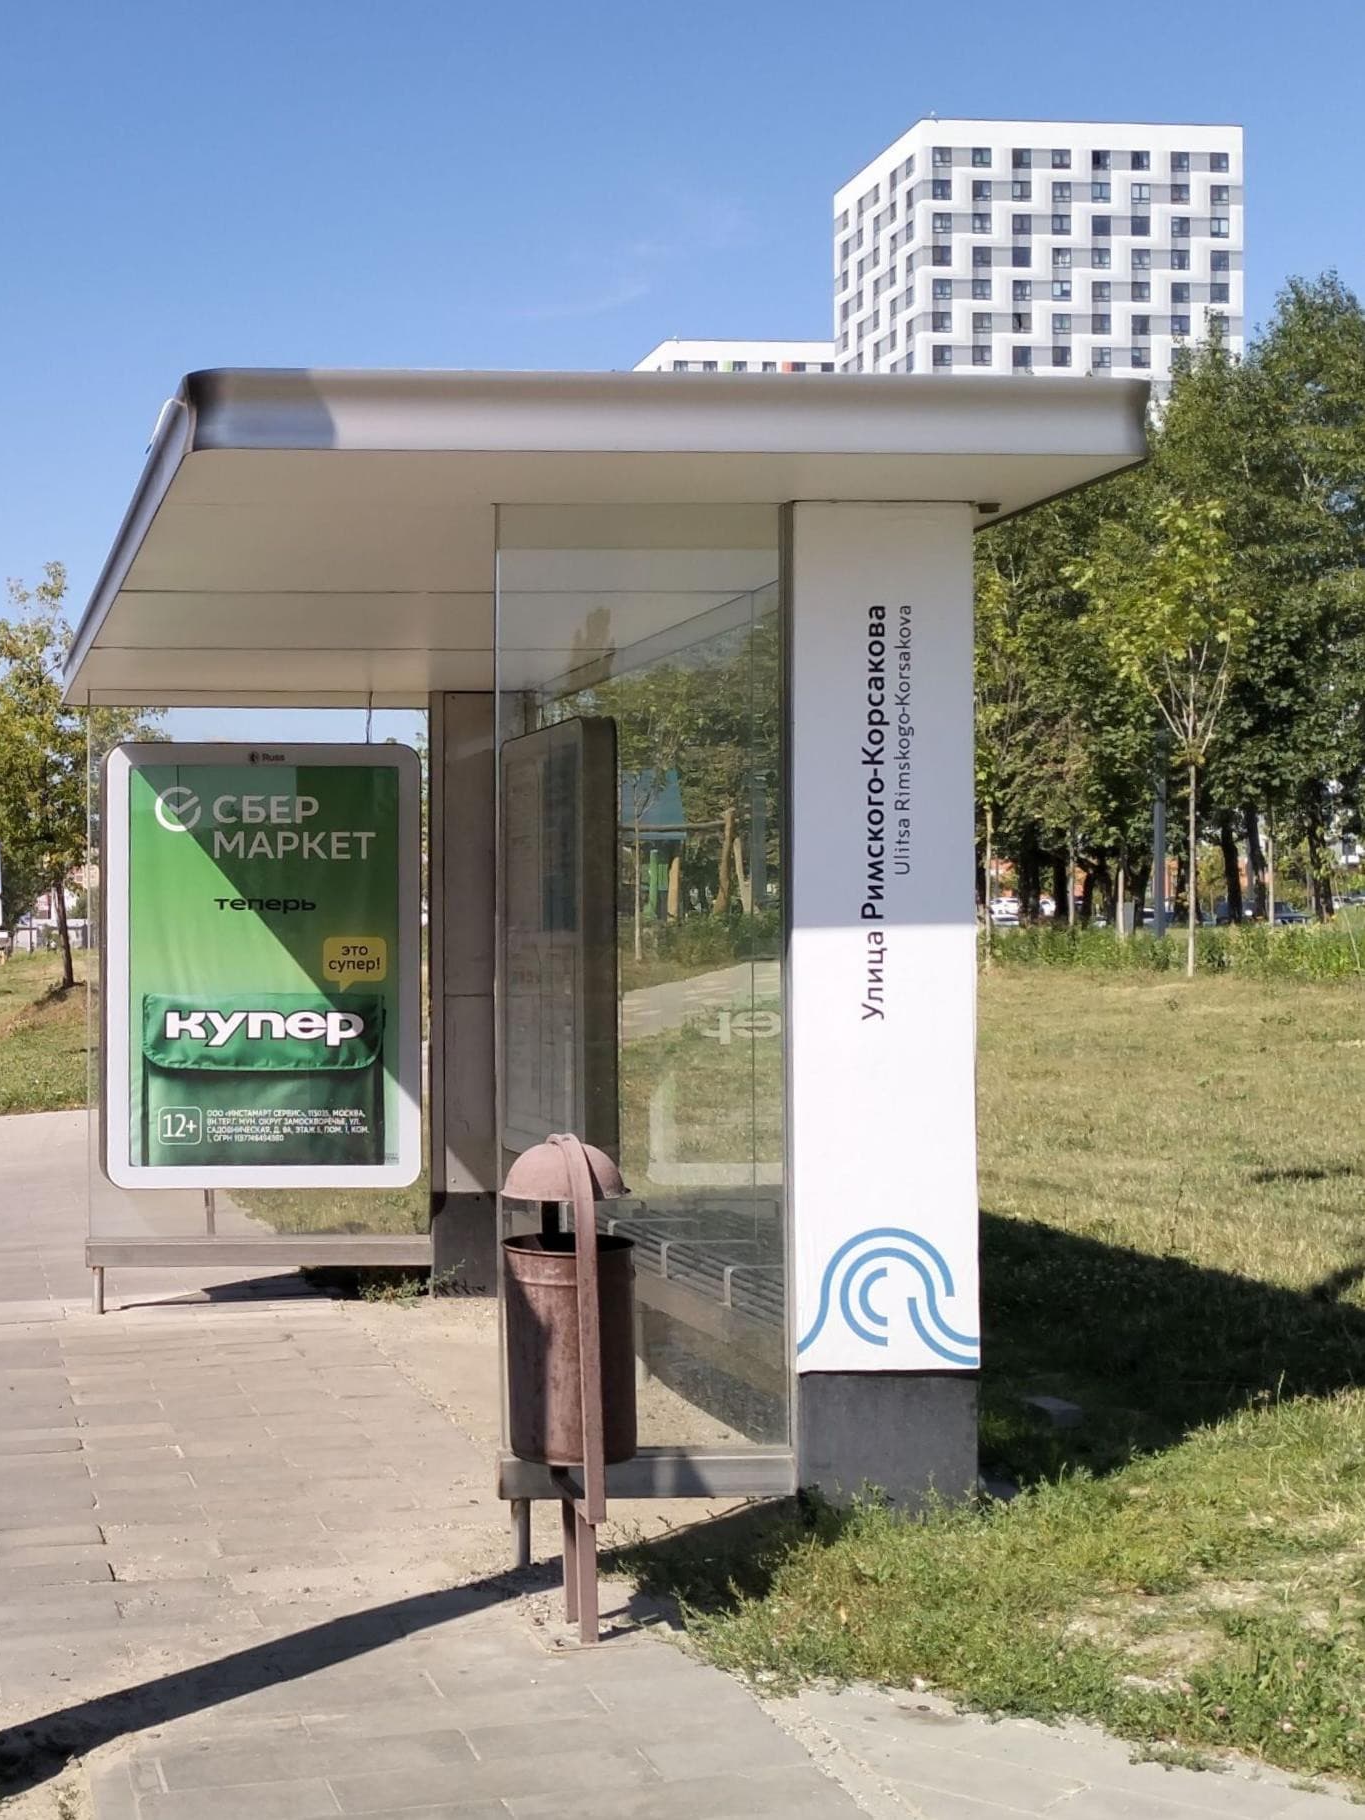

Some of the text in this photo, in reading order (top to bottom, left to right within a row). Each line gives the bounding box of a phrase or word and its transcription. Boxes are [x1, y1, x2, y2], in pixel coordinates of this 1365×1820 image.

[894, 604, 914, 875] Ulitsa Rimskogo-Korsakova
[212, 795, 319, 825] СБЕР
[861, 604, 890, 1021] Улица Римского-Корсакова
[213, 831, 376, 860] МАРКЕТ
[214, 897, 317, 914] теперь
[341, 944, 369, 957] это
[328, 957, 381, 973] супер!
[164, 1010, 365, 1047] купер
[162, 1114, 197, 1138] 12+
[206, 1109, 224, 1117] ООО
